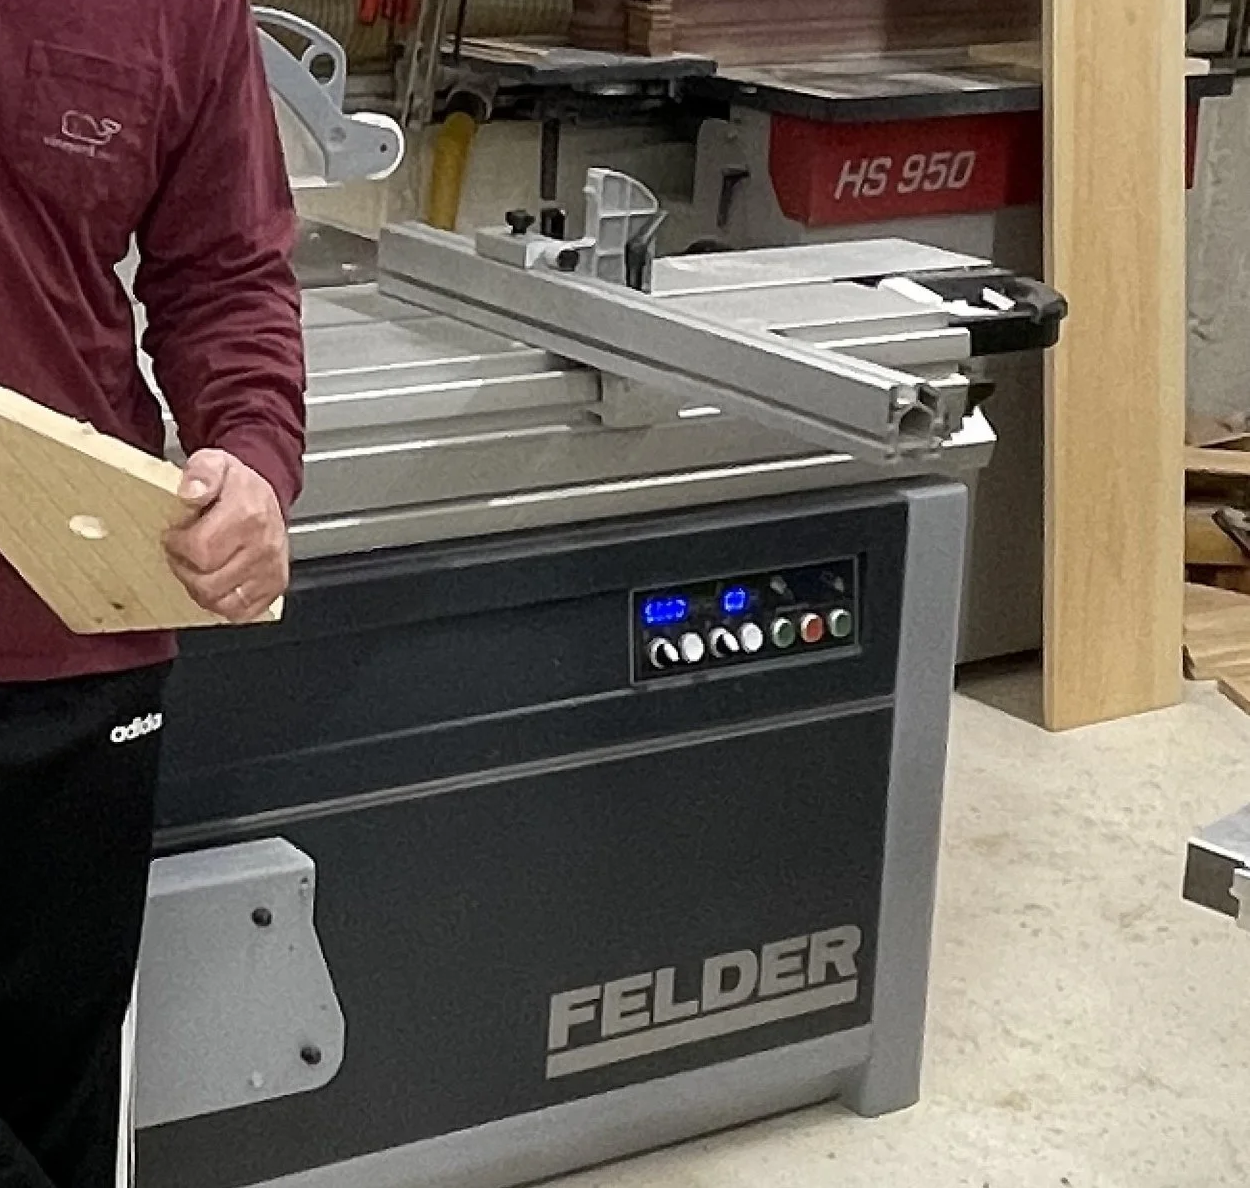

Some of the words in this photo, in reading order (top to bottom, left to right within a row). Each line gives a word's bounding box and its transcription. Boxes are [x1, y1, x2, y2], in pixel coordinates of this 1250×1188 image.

[834, 156, 892, 200] HS
[897, 150, 976, 194] 950
[110, 712, 163, 743] adida
[547, 924, 862, 1050] FELDER
